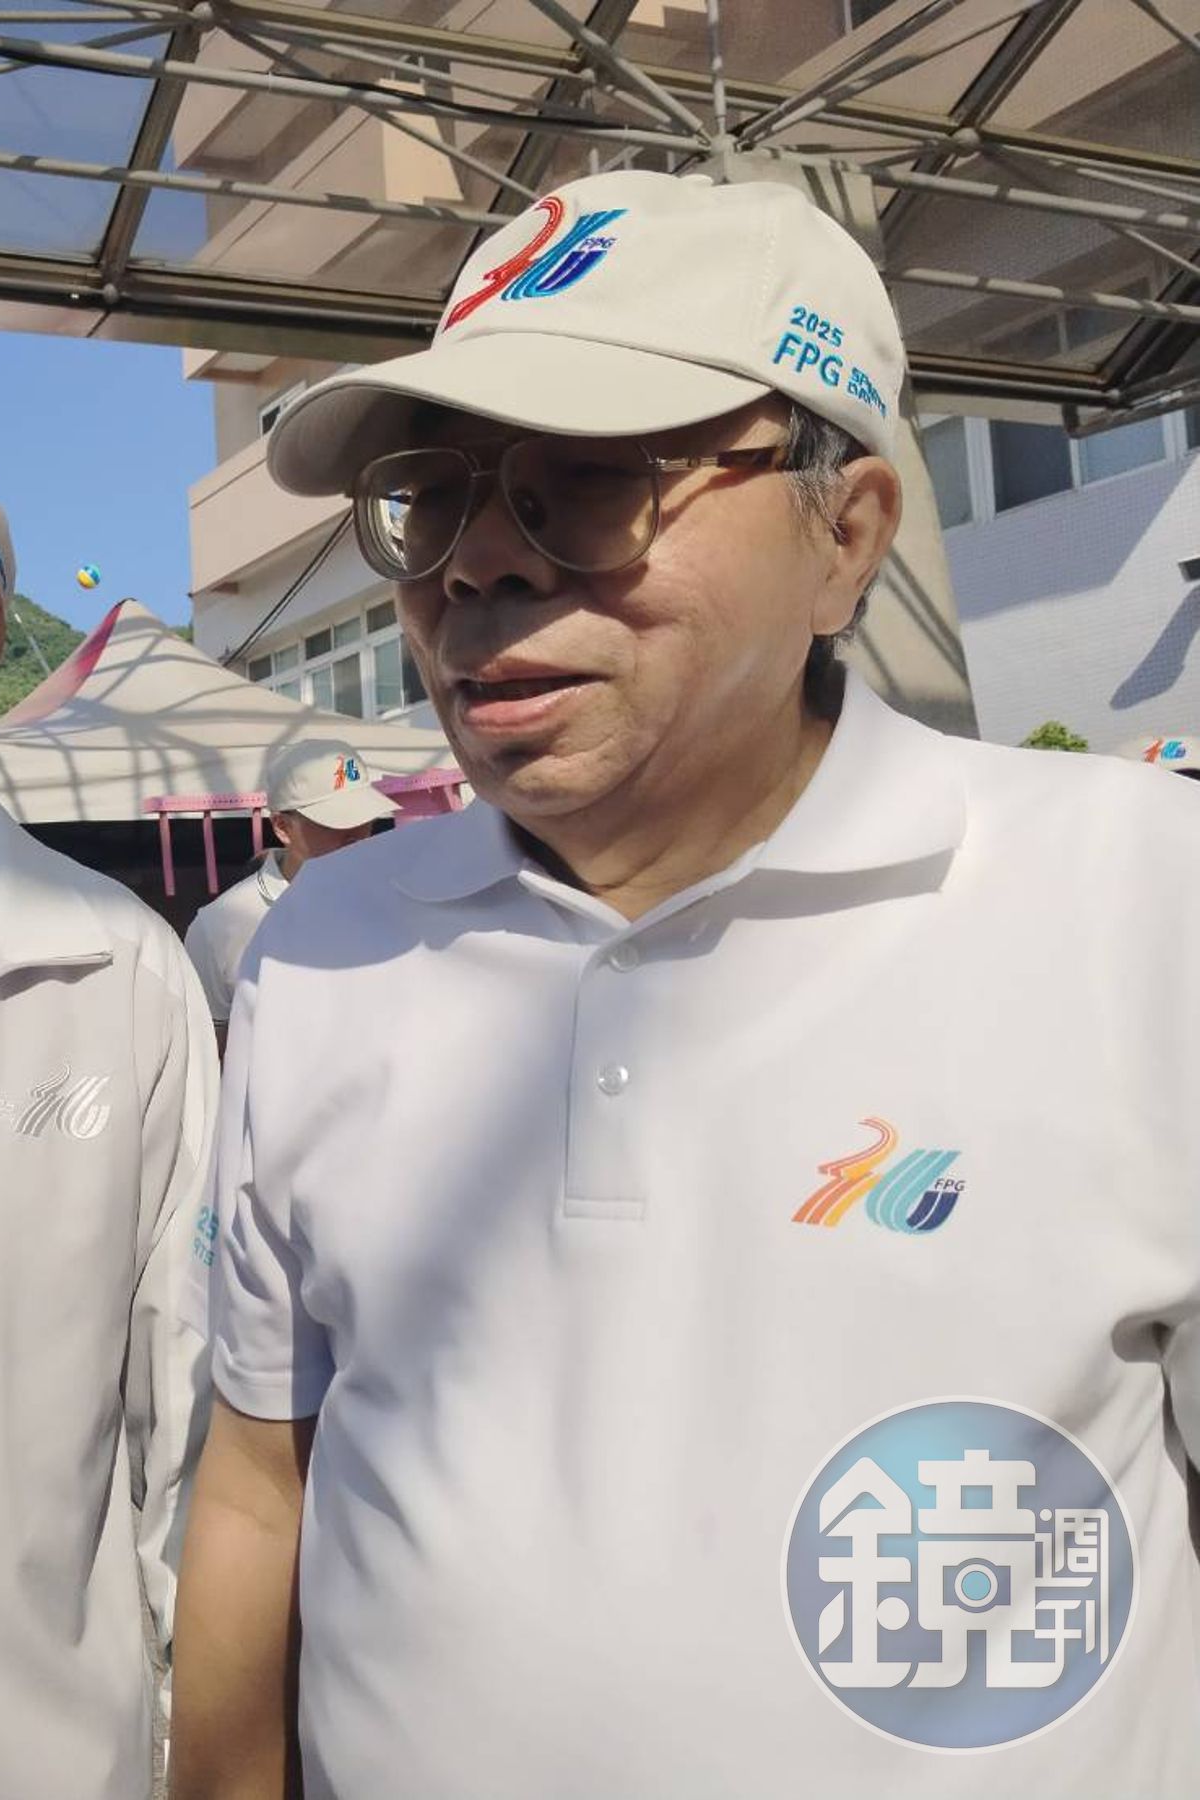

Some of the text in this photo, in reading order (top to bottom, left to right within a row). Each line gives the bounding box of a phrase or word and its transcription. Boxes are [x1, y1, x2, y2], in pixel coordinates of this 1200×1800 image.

[790, 304, 844, 347] 2025
[772, 331, 843, 387] FPG
[933, 1178, 966, 1192] FPG
